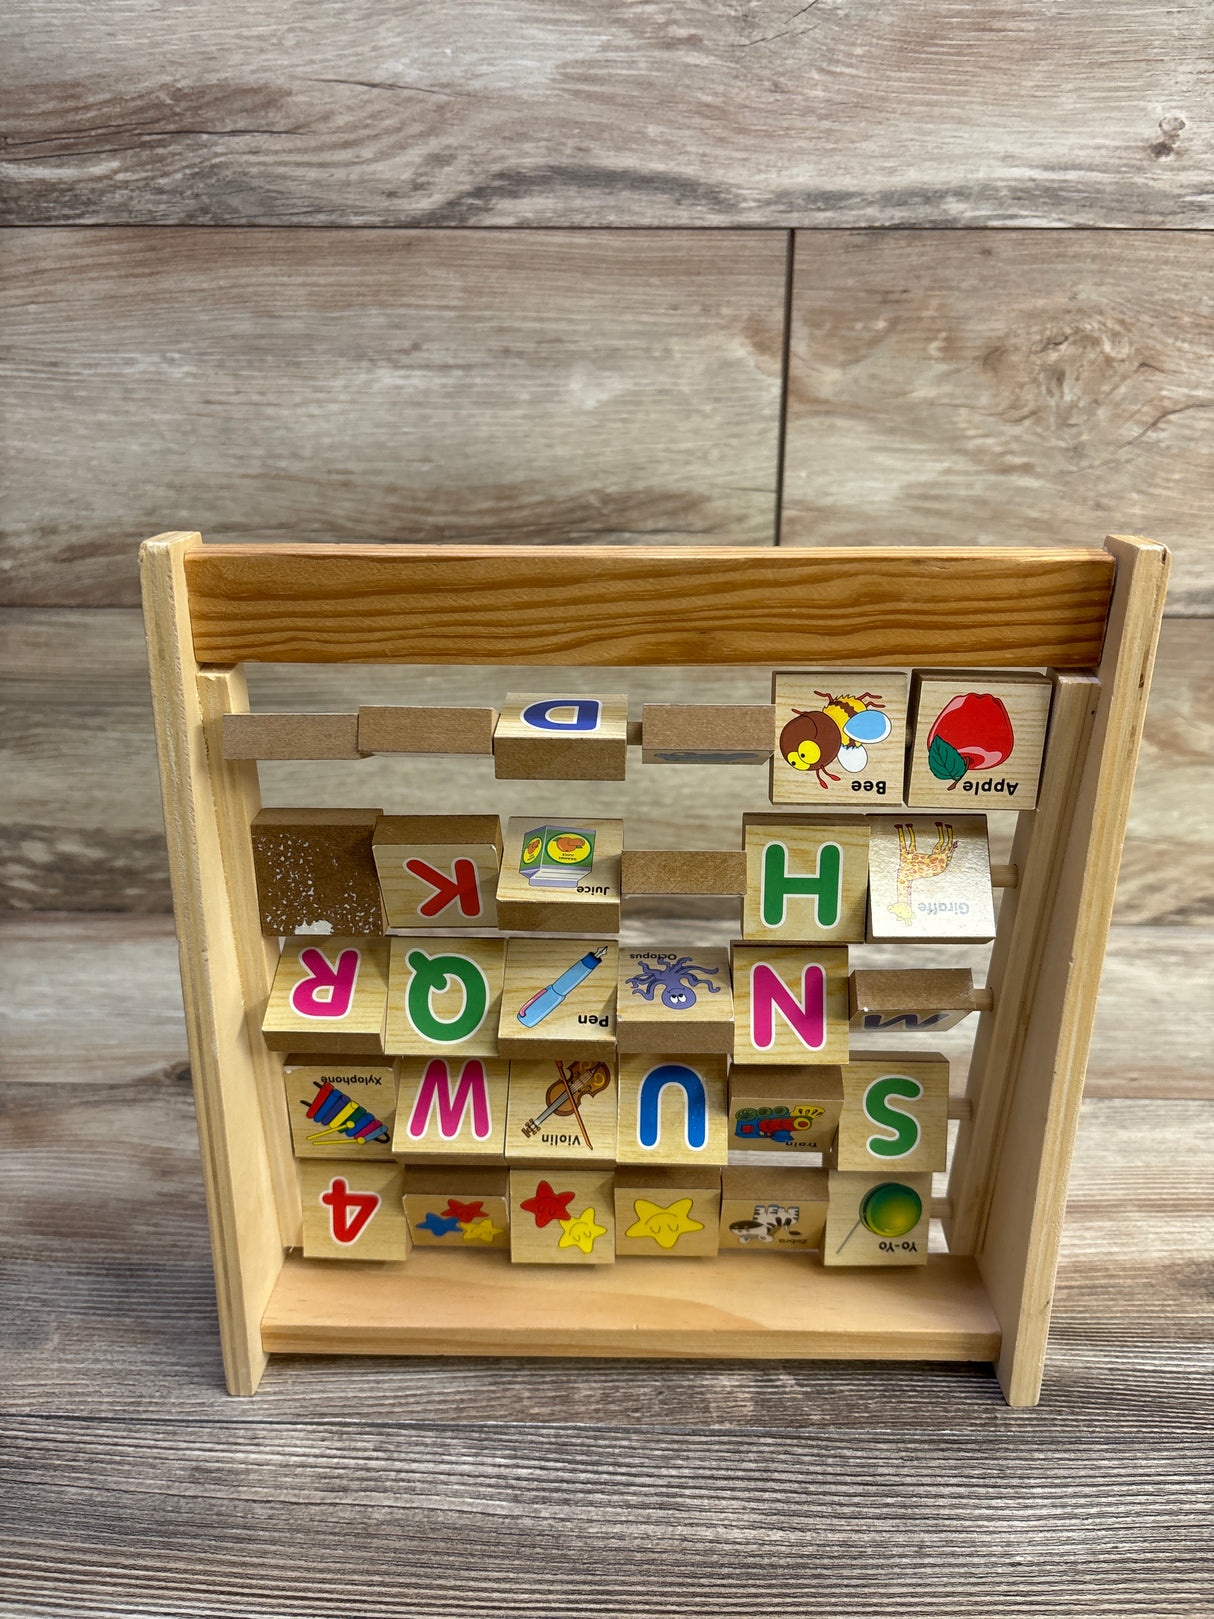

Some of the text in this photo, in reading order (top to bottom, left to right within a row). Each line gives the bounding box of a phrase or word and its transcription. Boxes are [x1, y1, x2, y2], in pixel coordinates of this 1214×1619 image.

[522, 699, 600, 732] D
[851, 779, 887, 795] Bee
[962, 779, 1019, 796] Apple
[405, 857, 482, 918] K
[576, 886, 611, 896] Juice
[761, 841, 843, 928] H
[917, 901, 970, 916] Giraffe
[629, 952, 678, 961] Octopus
[291, 948, 361, 1018] R
[407, 949, 489, 1044] Q
[751, 962, 826, 1050] N
[578, 1014, 610, 1028] Pen
[320, 1075, 382, 1086] Xylophone
[638, 1063, 708, 1151] U
[863, 1075, 924, 1158] S
[541, 1134, 581, 1146] Violin
[319, 1177, 382, 1244] 4
[878, 1241, 918, 1253] Yo-Yo
